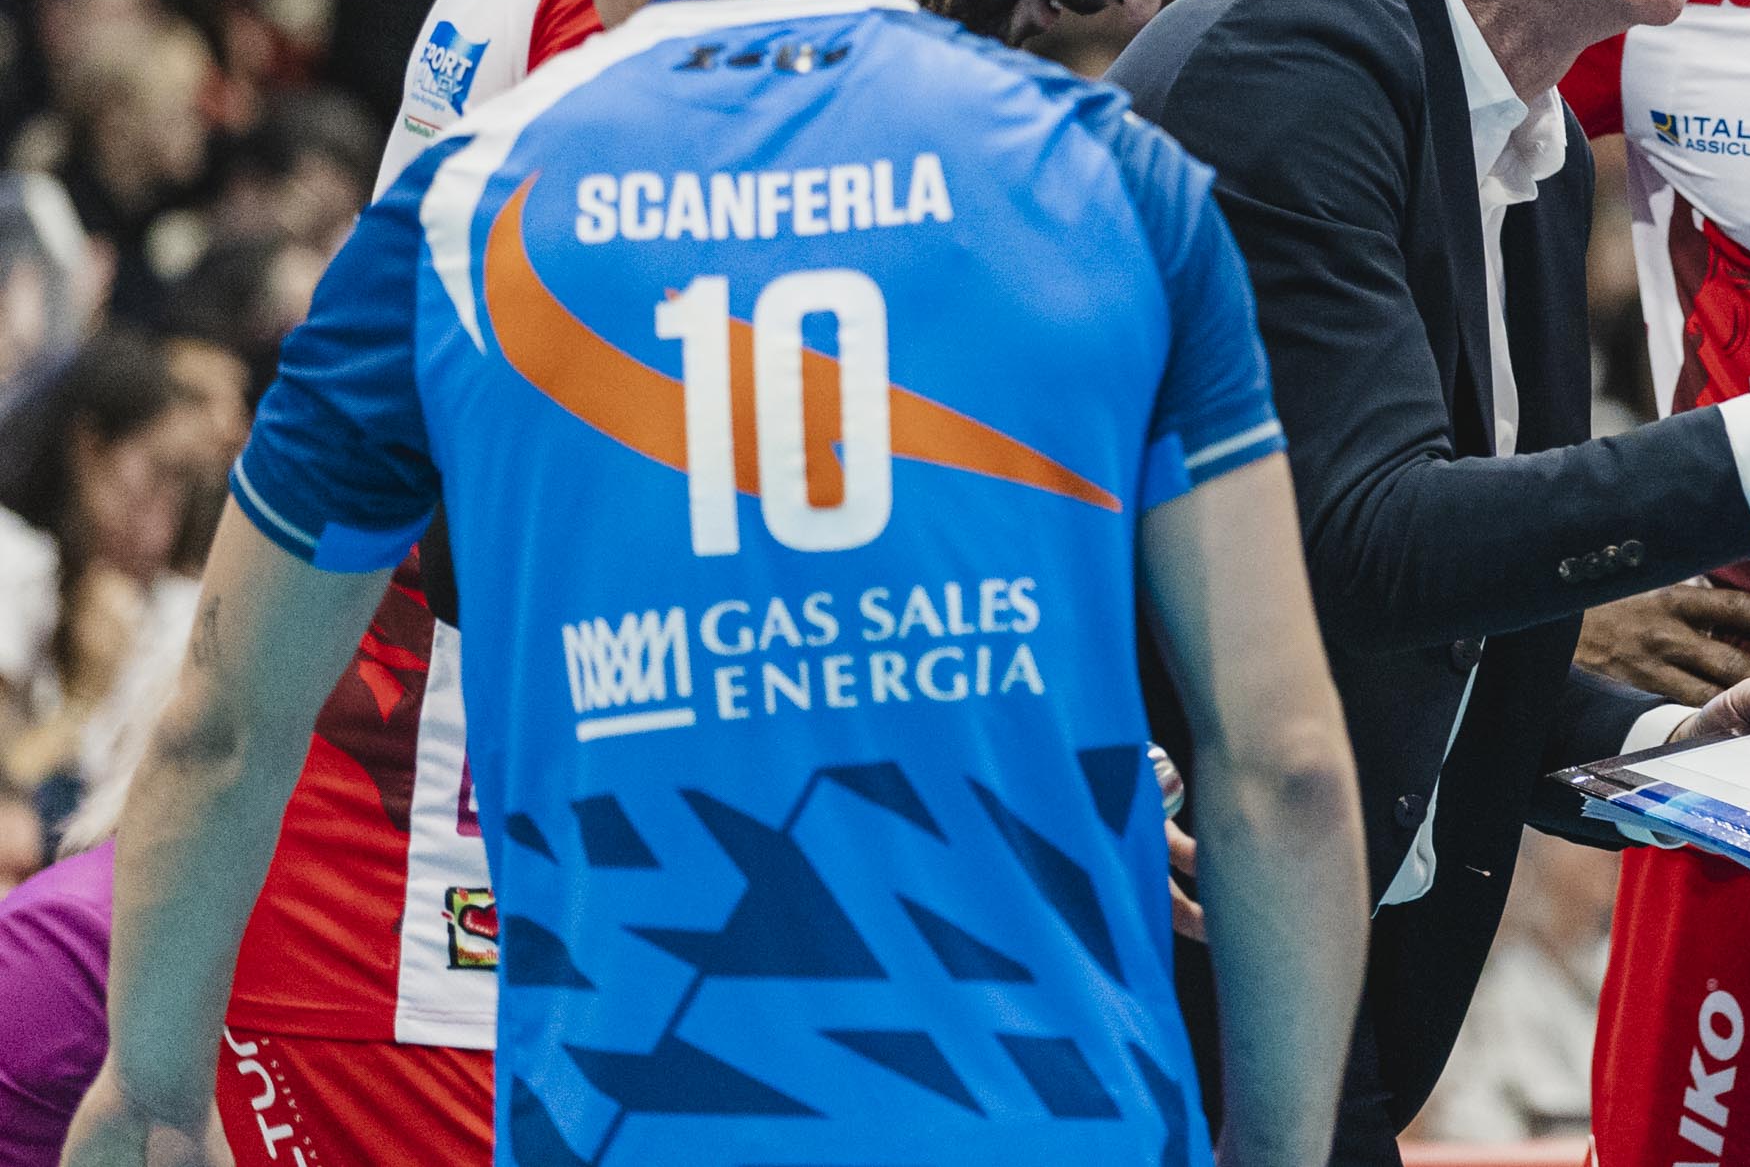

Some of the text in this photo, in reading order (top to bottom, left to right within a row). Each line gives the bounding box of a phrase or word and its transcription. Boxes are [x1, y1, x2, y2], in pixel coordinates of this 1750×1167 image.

[576, 153, 953, 243] SCANFERLA
[655, 267, 893, 557] 10
[700, 577, 1041, 656] GAS SALES
[714, 643, 1046, 721] ENERGIA
[1672, 990, 1745, 1167] IKO
